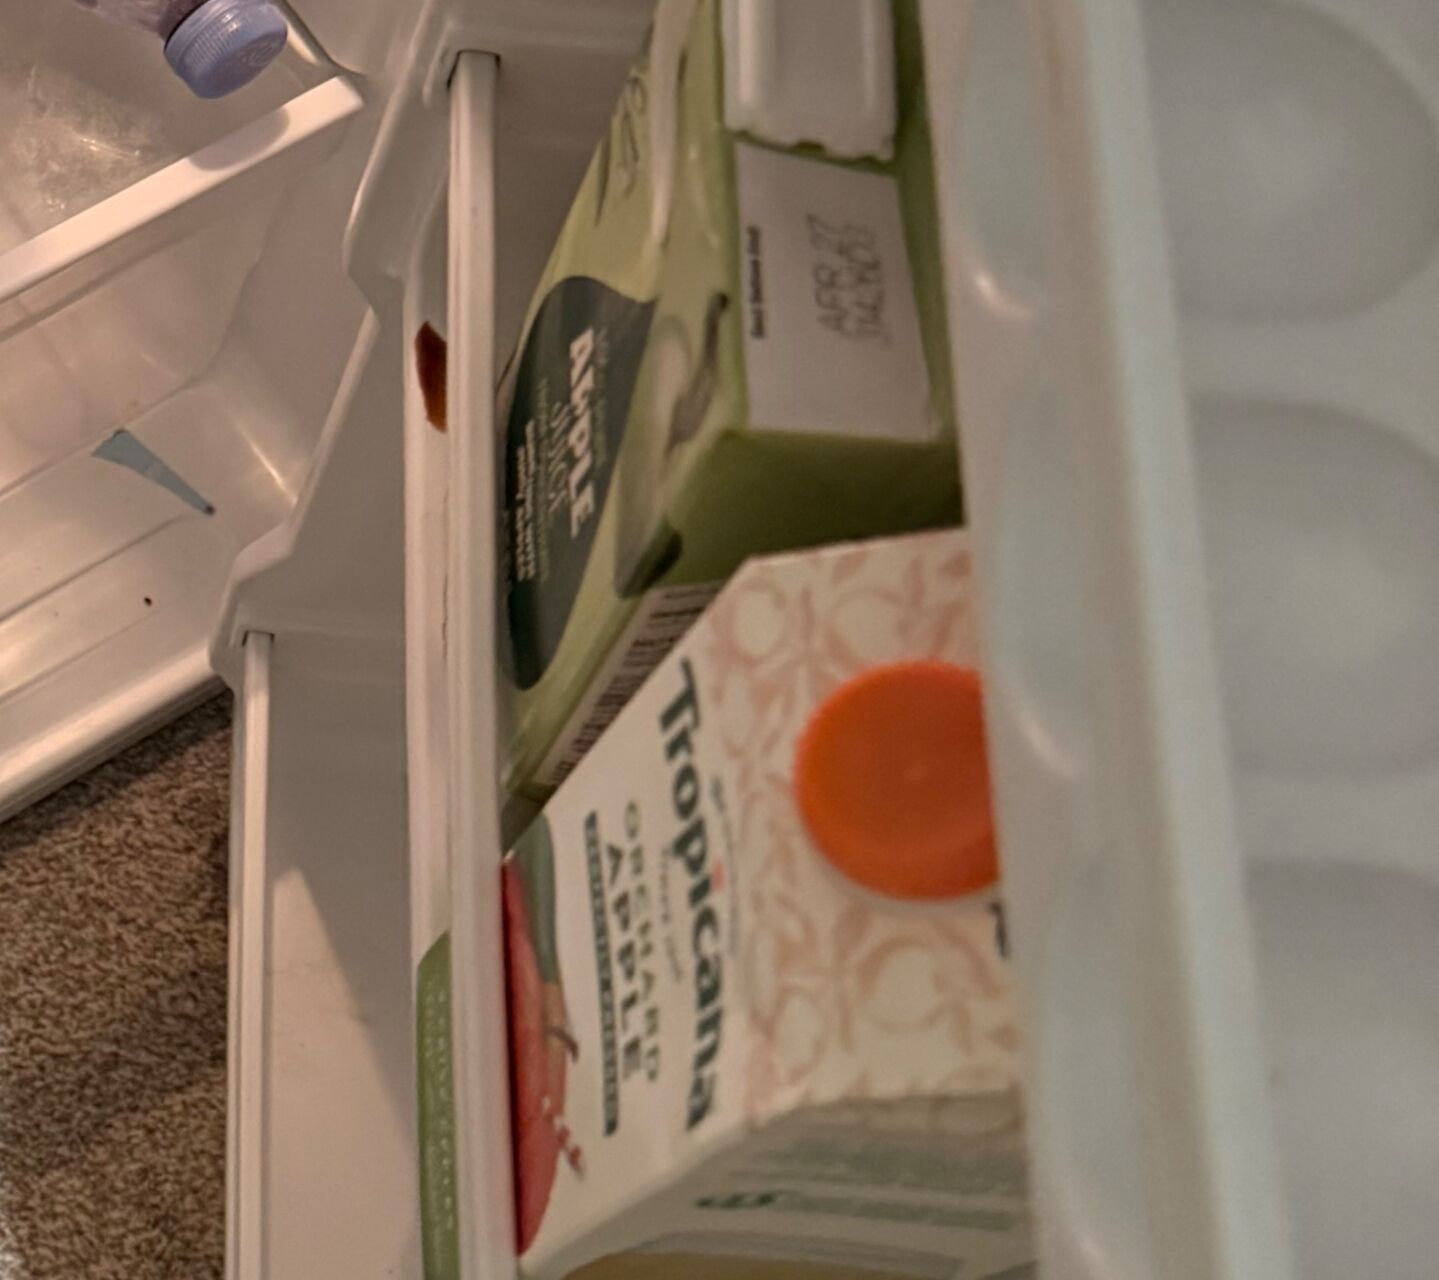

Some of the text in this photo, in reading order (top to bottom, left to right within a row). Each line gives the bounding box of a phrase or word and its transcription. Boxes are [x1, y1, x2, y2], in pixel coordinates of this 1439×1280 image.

[567, 327, 593, 538] APPLE
[600, 844, 641, 1083] APPLE
[619, 800, 661, 1081] ORCHARD
[654, 658, 724, 1132] Tropicana
